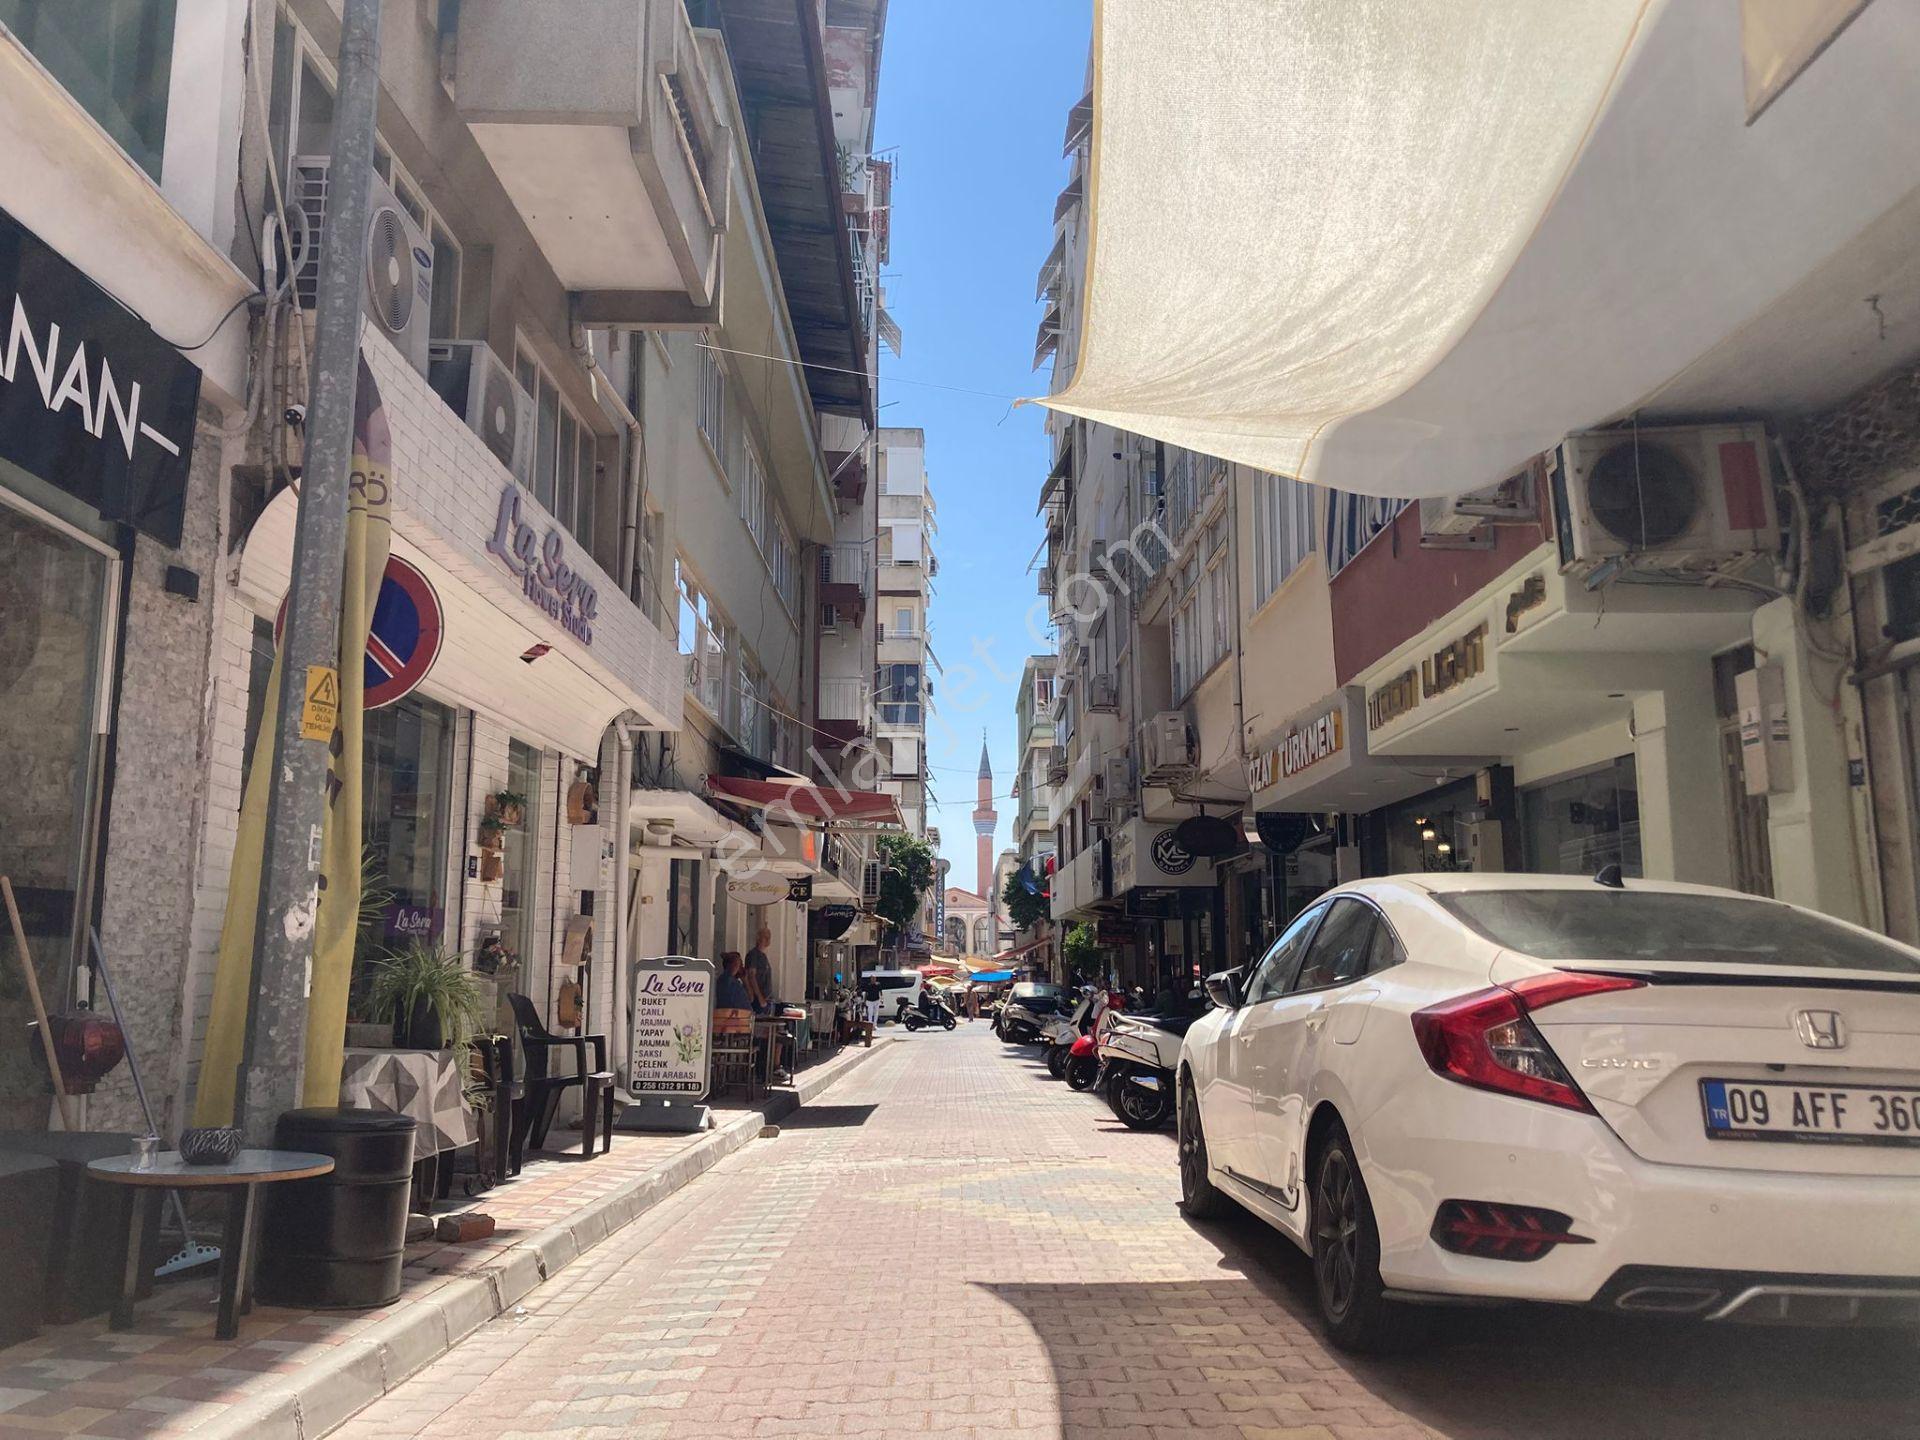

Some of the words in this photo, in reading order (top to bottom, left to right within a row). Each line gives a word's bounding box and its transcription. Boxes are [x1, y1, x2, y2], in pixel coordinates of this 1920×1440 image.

[485, 485, 538, 577] La
[536, 530, 599, 621] Sera
[1278, 711, 1338, 778] TÜRKMEN
[394, 909, 409, 931] La
[641, 973, 664, 996] La
[667, 975, 705, 993] Sera
[641, 998, 667, 1006] BUKET
[641, 1008, 665, 1016] CANLI
[640, 1029, 664, 1037] YAPAY
[638, 1060, 668, 1069] ÇELENK
[1581, 1058, 1661, 1069] CIVIC
[662, 1071, 696, 1079] ARABASI
[1713, 1108, 1727, 1120] TR
[1728, 1088, 1769, 1125] 09
[1792, 1091, 1848, 1129] AFF
